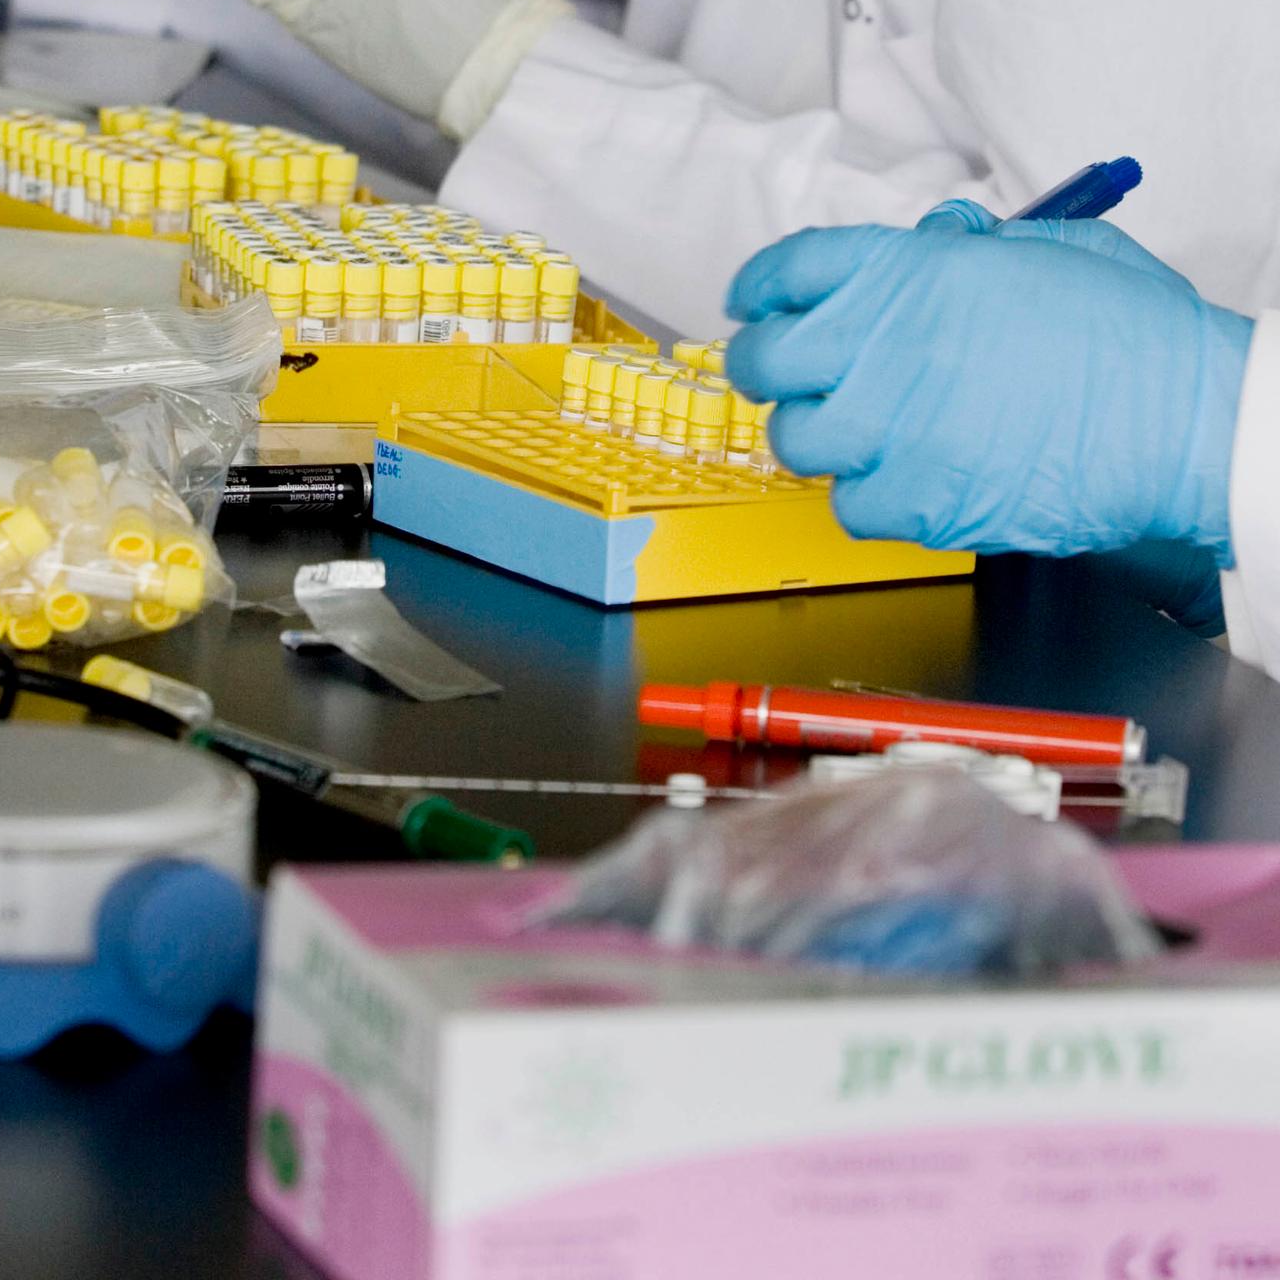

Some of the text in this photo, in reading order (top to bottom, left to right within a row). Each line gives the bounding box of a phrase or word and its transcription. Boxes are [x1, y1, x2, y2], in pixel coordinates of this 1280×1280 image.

[310, 483, 336, 492] Pointe
[290, 493, 336, 502] Bullet Point
